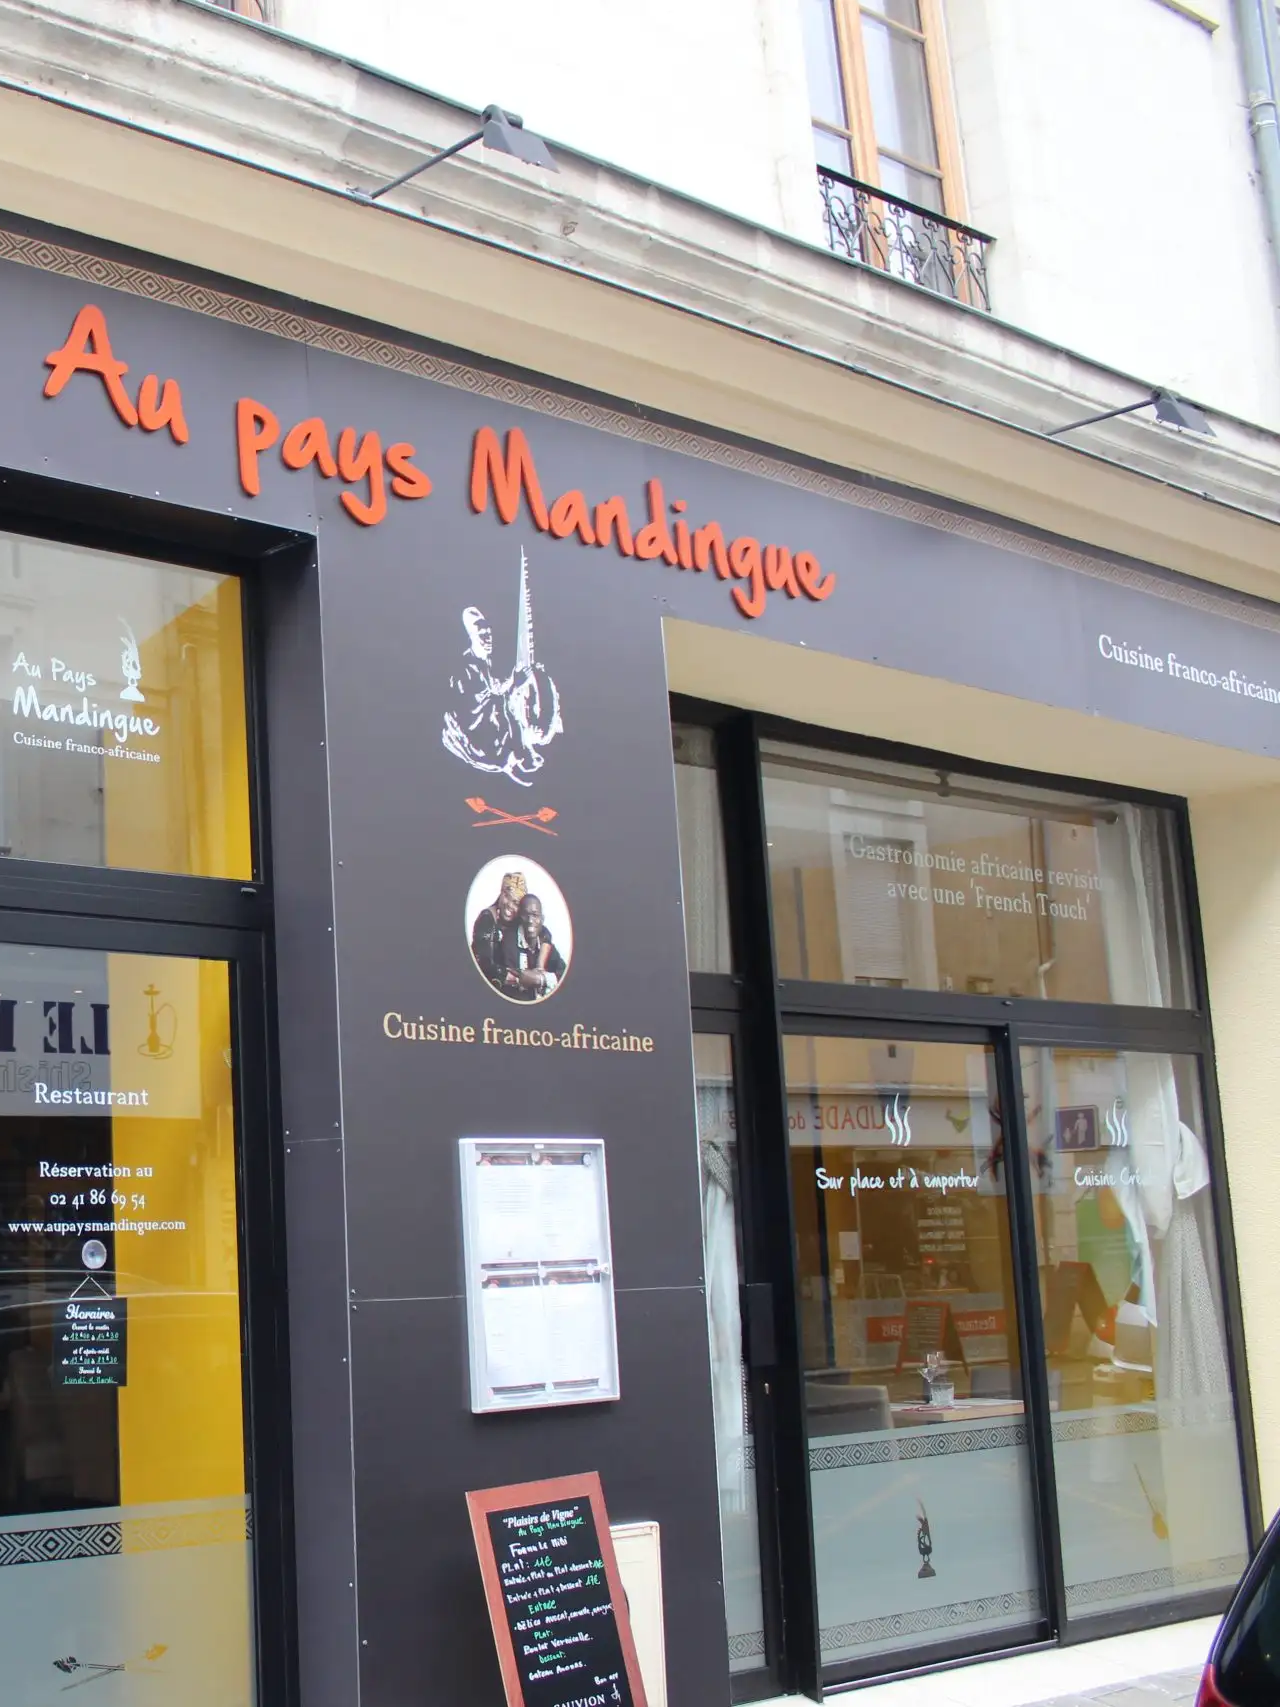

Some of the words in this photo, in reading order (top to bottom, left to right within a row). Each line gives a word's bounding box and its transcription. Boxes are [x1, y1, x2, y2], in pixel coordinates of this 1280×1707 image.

[43, 304, 189, 444] Au
[236, 396, 432, 525] pays
[471, 424, 836, 618] Mandingue
[1098, 634, 1164, 673] Cuisine
[12, 652, 41, 679] Au
[51, 657, 96, 693] Pays
[13, 685, 160, 743] Mandingue
[13, 731, 62, 749] Cuisine
[65, 739, 160, 763] franco-africaine
[850, 835, 966, 873] Gastronomie
[971, 853, 1044, 882] africaine
[1048, 869, 1104, 891] revisit
[887, 882, 928, 901] avec
[933, 887, 965, 906] une
[383, 1012, 475, 1043] Cuisine
[482, 1018, 653, 1052] franco-africaine
[34, 1082, 149, 1105] Restaurant
[39, 1161, 131, 1178] Réservation
[136, 1166, 153, 1178] au
[815, 1167, 844, 1189] Sur
[850, 1167, 885, 1197] place
[889, 1168, 905, 1188] et
[909, 1167, 919, 1188] à
[924, 1167, 979, 1195] emporter
[1074, 1167, 1116, 1187] Cuisine
[50, 1194, 66, 1205] 02
[72, 1194, 84, 1210] 41
[89, 1189, 106, 1205] 86
[111, 1189, 126, 1210] 69
[131, 1194, 145, 1210] 54
[8, 1219, 186, 1236] www.aupaysmandingue.com
[65, 1303, 115, 1319] Horaires
